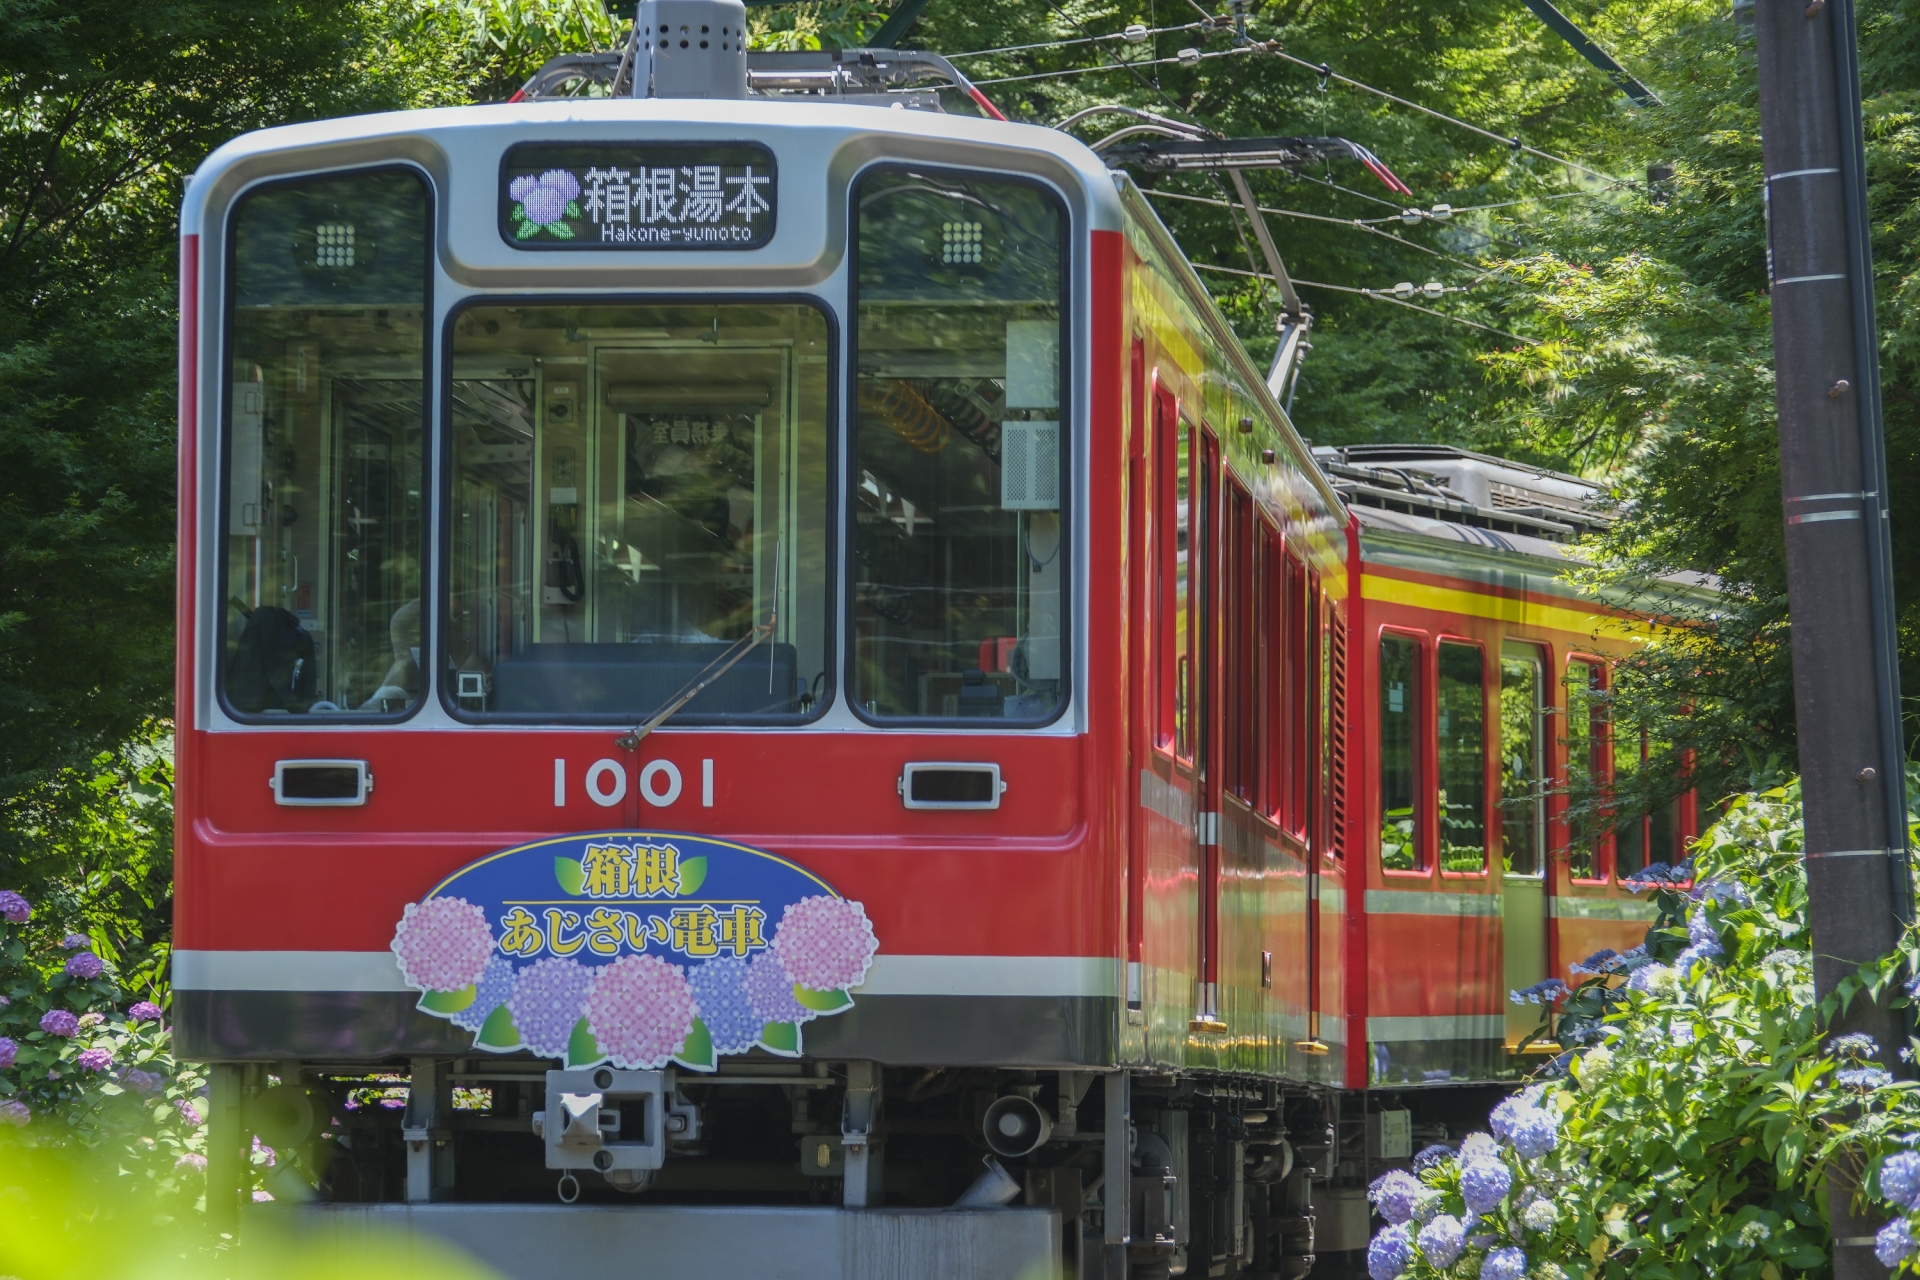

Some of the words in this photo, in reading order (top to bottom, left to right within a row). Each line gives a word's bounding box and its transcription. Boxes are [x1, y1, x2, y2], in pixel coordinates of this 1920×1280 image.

[584, 165, 770, 223] 箱根湯本
[601, 223, 752, 242] Hakone-yumoto
[553, 757, 714, 808] 1001
[581, 843, 681, 898] 箱根
[499, 904, 768, 958] あじさい電車
